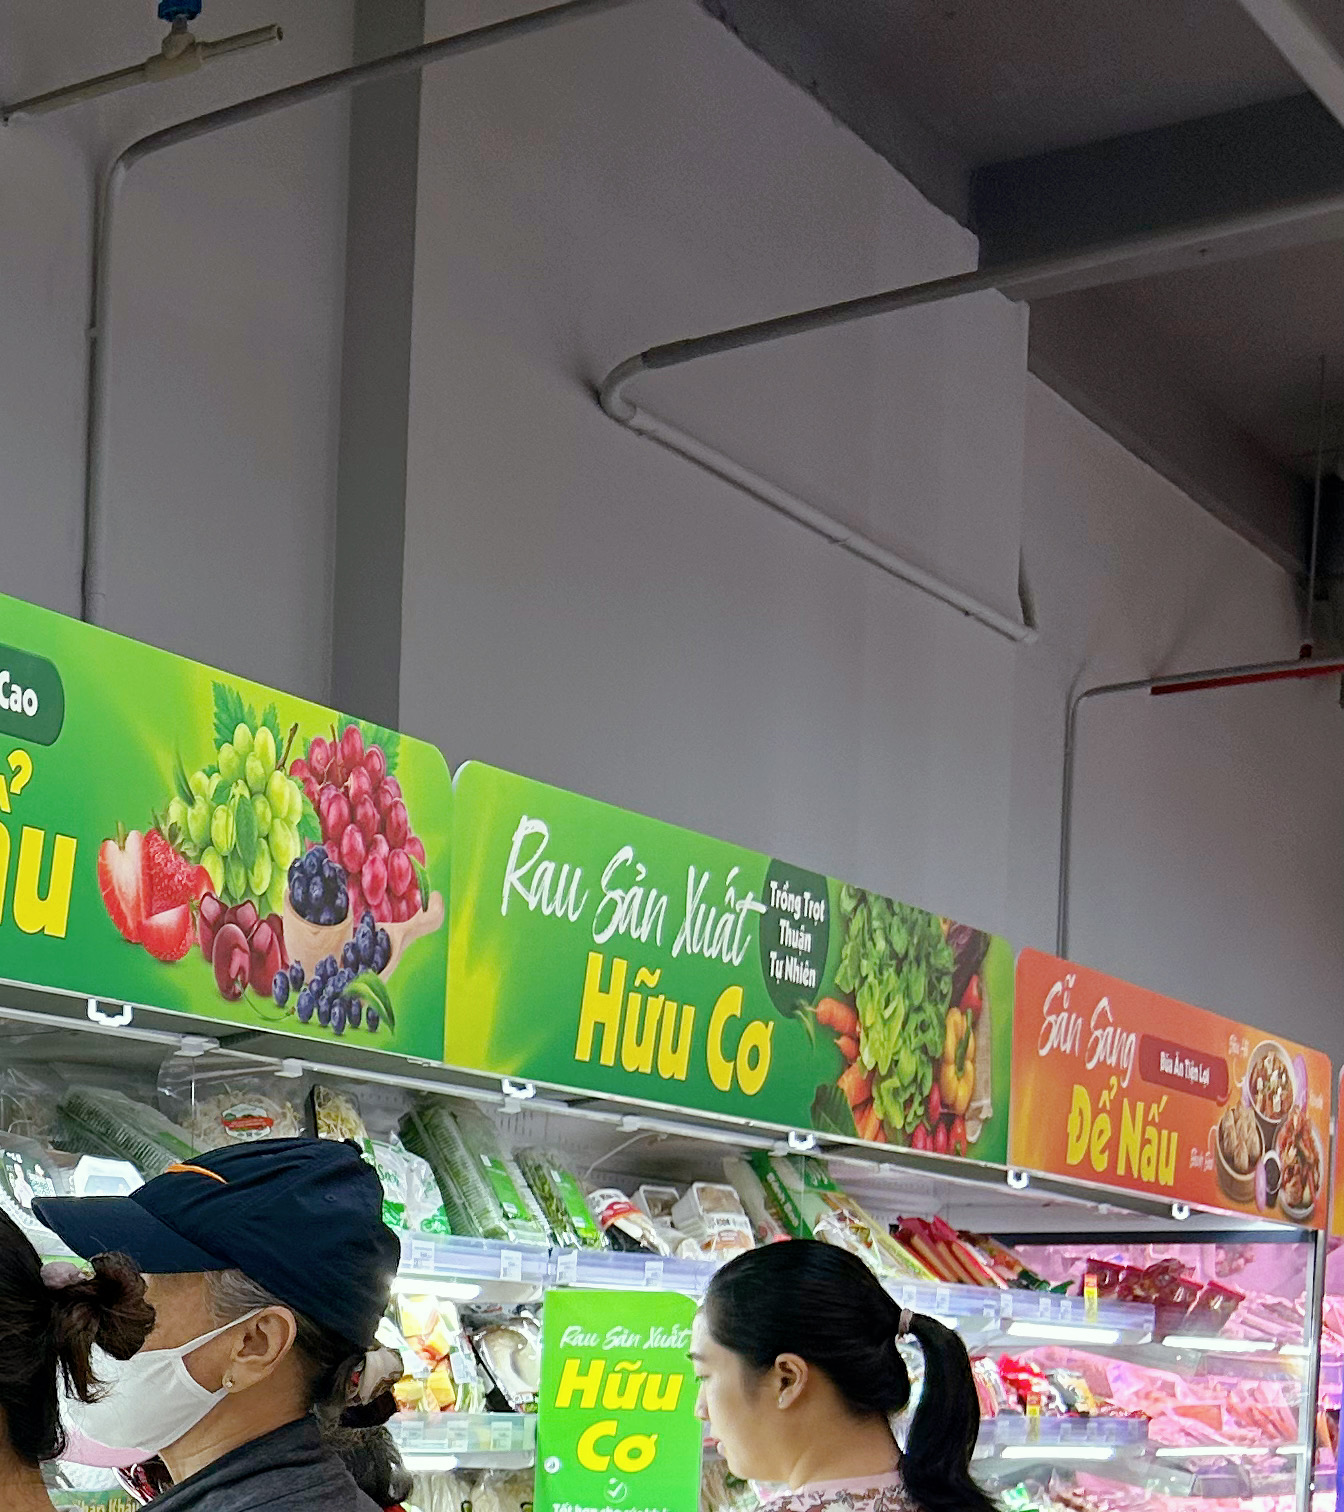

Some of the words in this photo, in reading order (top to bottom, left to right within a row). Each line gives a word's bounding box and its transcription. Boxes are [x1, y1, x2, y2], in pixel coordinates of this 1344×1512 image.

[501, 815, 590, 923] Rau
[592, 845, 669, 948] Sản
[671, 865, 767, 967] Xuất
[803, 891, 825, 926] Trọt
[779, 918, 811, 956] Thuận
[784, 955, 816, 988] Nhiên
[574, 951, 698, 1080] Hữu
[705, 984, 776, 1097] Cơ
[1038, 973, 1082, 1057] Sẵn
[1085, 996, 1137, 1088] Sàng
[1066, 1075, 1118, 1172] Để
[1116, 1094, 1178, 1186] Nấu
[560, 1325, 600, 1350] Rau
[602, 1325, 642, 1350] Sản
[643, 1322, 693, 1350] Xuất
[554, 1358, 684, 1412] Hữu
[576, 1419, 659, 1474] Cơ
